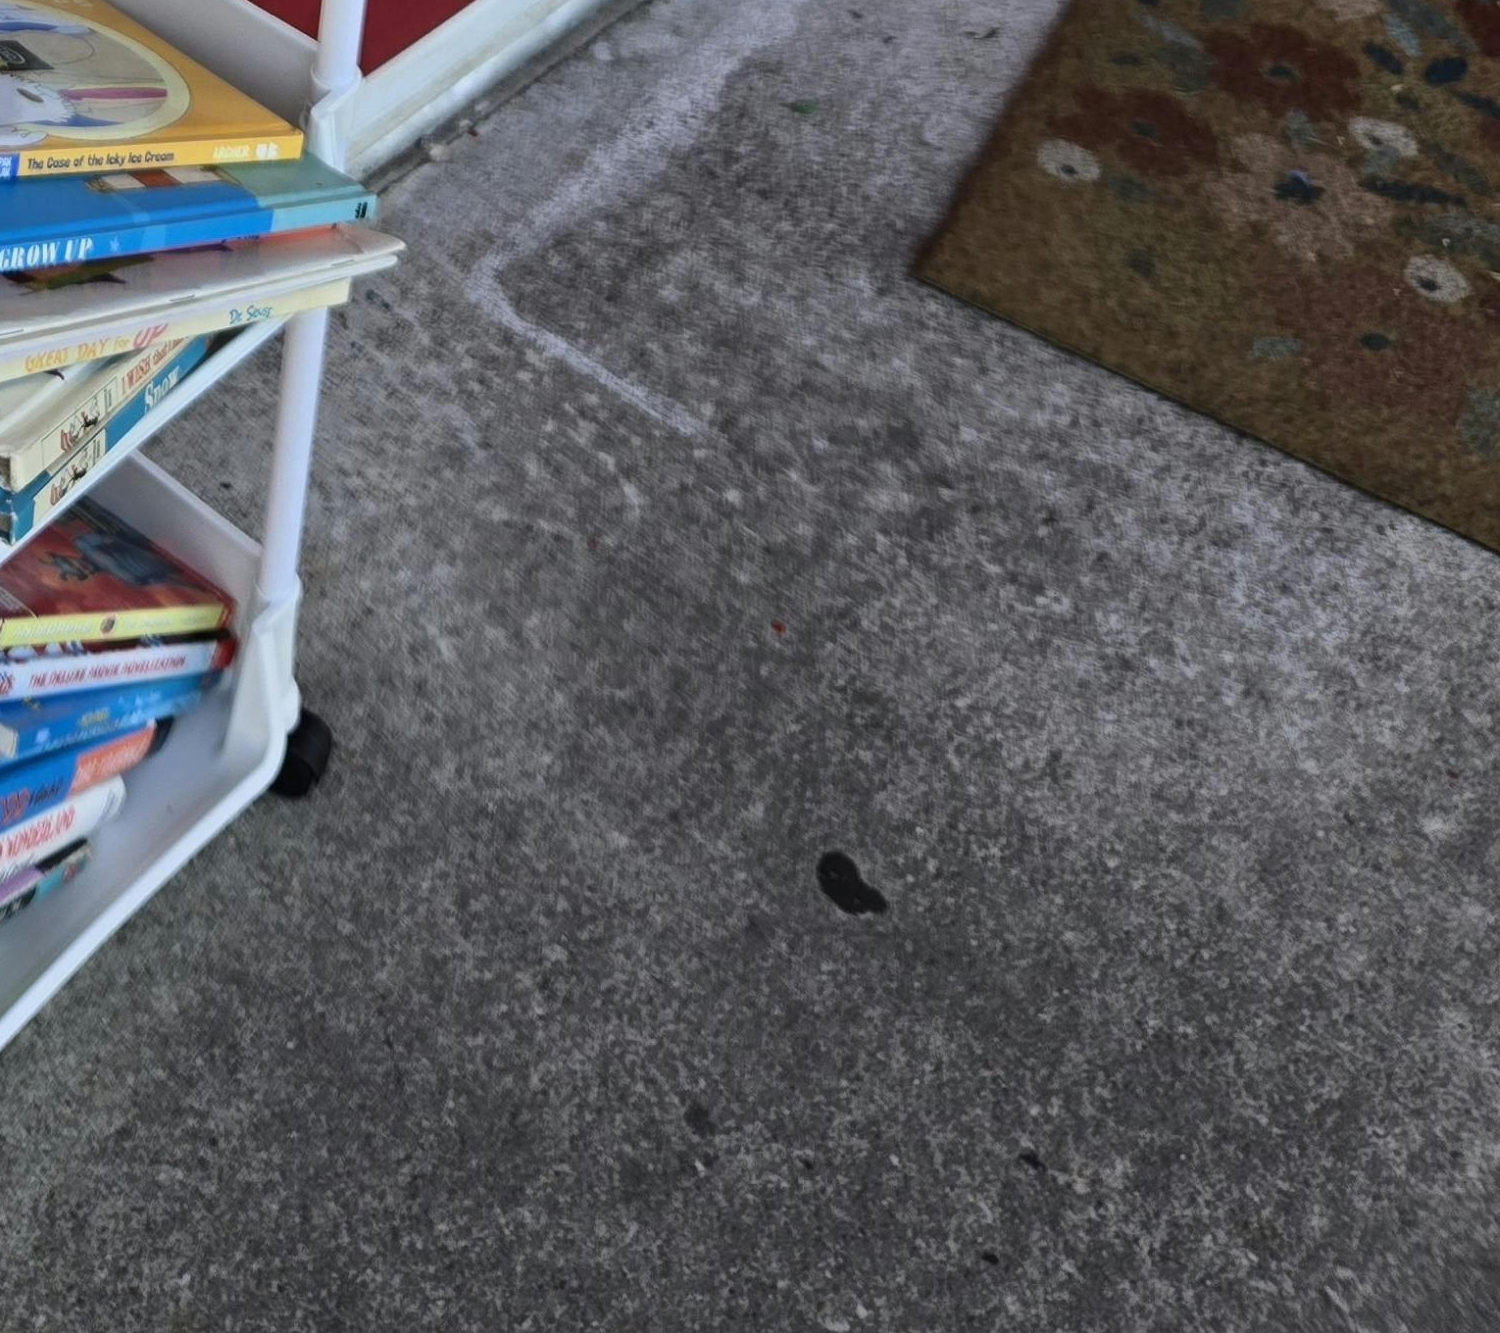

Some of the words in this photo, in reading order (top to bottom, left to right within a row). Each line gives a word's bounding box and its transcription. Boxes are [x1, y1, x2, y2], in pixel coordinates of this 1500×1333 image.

[27, 158, 44, 170] The
[47, 156, 70, 169] Case
[73, 155, 84, 167] of
[87, 153, 104, 166] the
[105, 153, 125, 167] Icky
[127, 152, 143, 164] Ice
[144, 151, 174, 164] Cream
[59, 235, 94, 263] UP
[24, 346, 69, 374] GREAT
[77, 337, 109, 362] DAY
[246, 304, 274, 321] Seuss
[127, 353, 152, 388] WISH
[144, 364, 181, 414] Snow
[30, 674, 47, 688] THE
[5, 803, 77, 859] WONDERLAND
